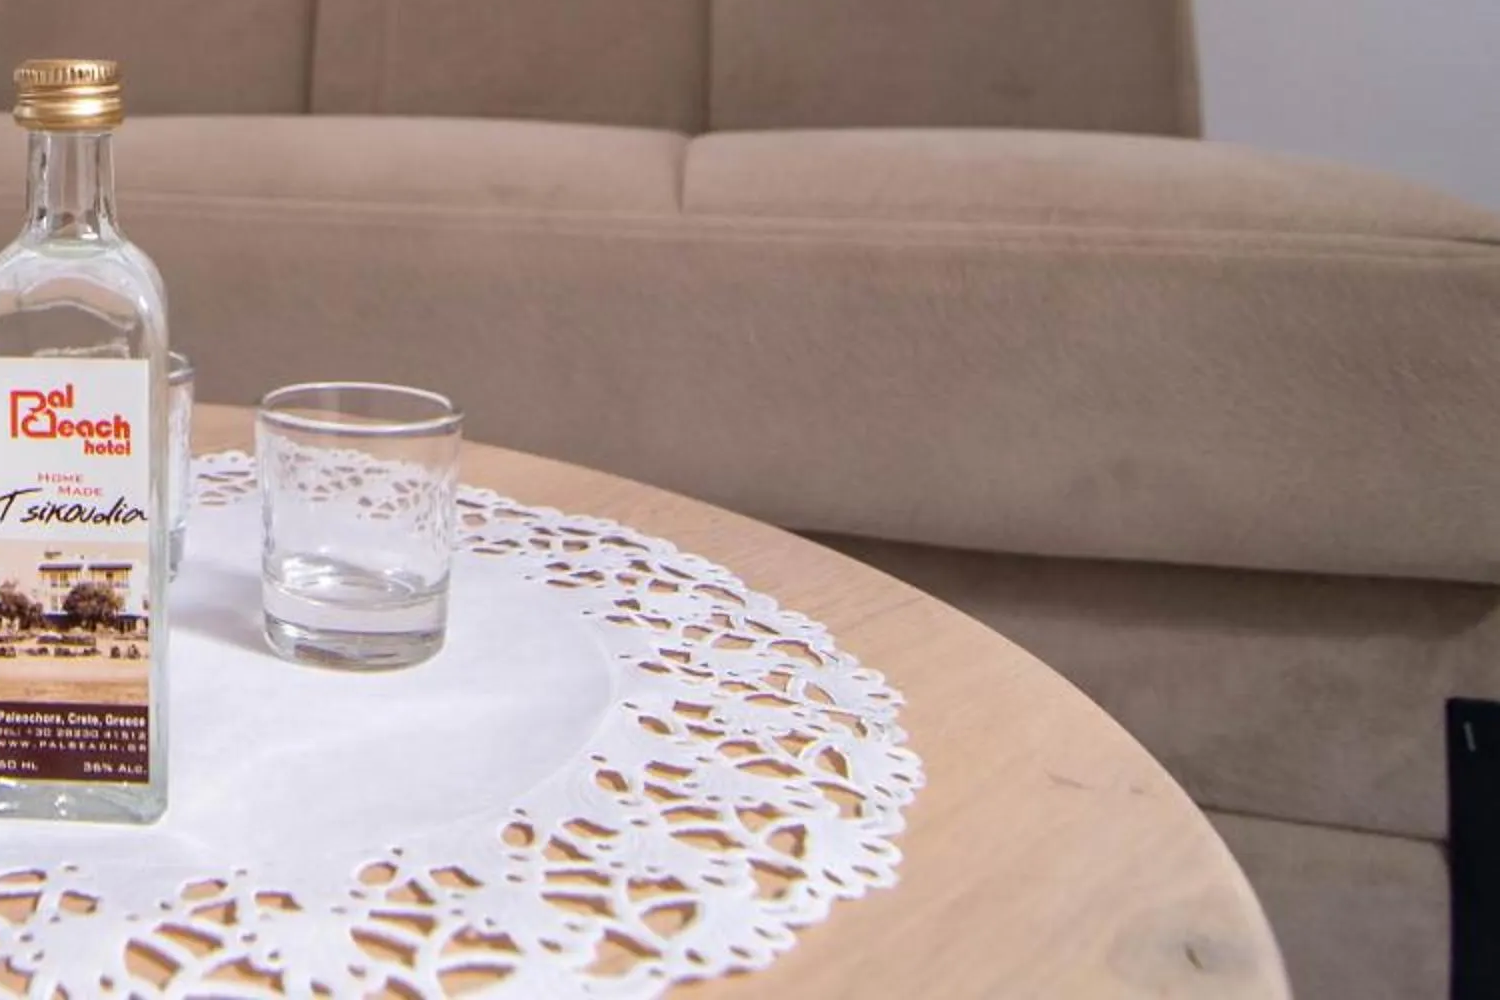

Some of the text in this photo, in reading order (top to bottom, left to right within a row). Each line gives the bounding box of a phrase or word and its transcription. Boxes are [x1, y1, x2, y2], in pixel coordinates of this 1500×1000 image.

[21, 407, 131, 439] Beach
[84, 440, 131, 456] hotel
[38, 472, 83, 483] HOME
[57, 485, 103, 497] MADE
